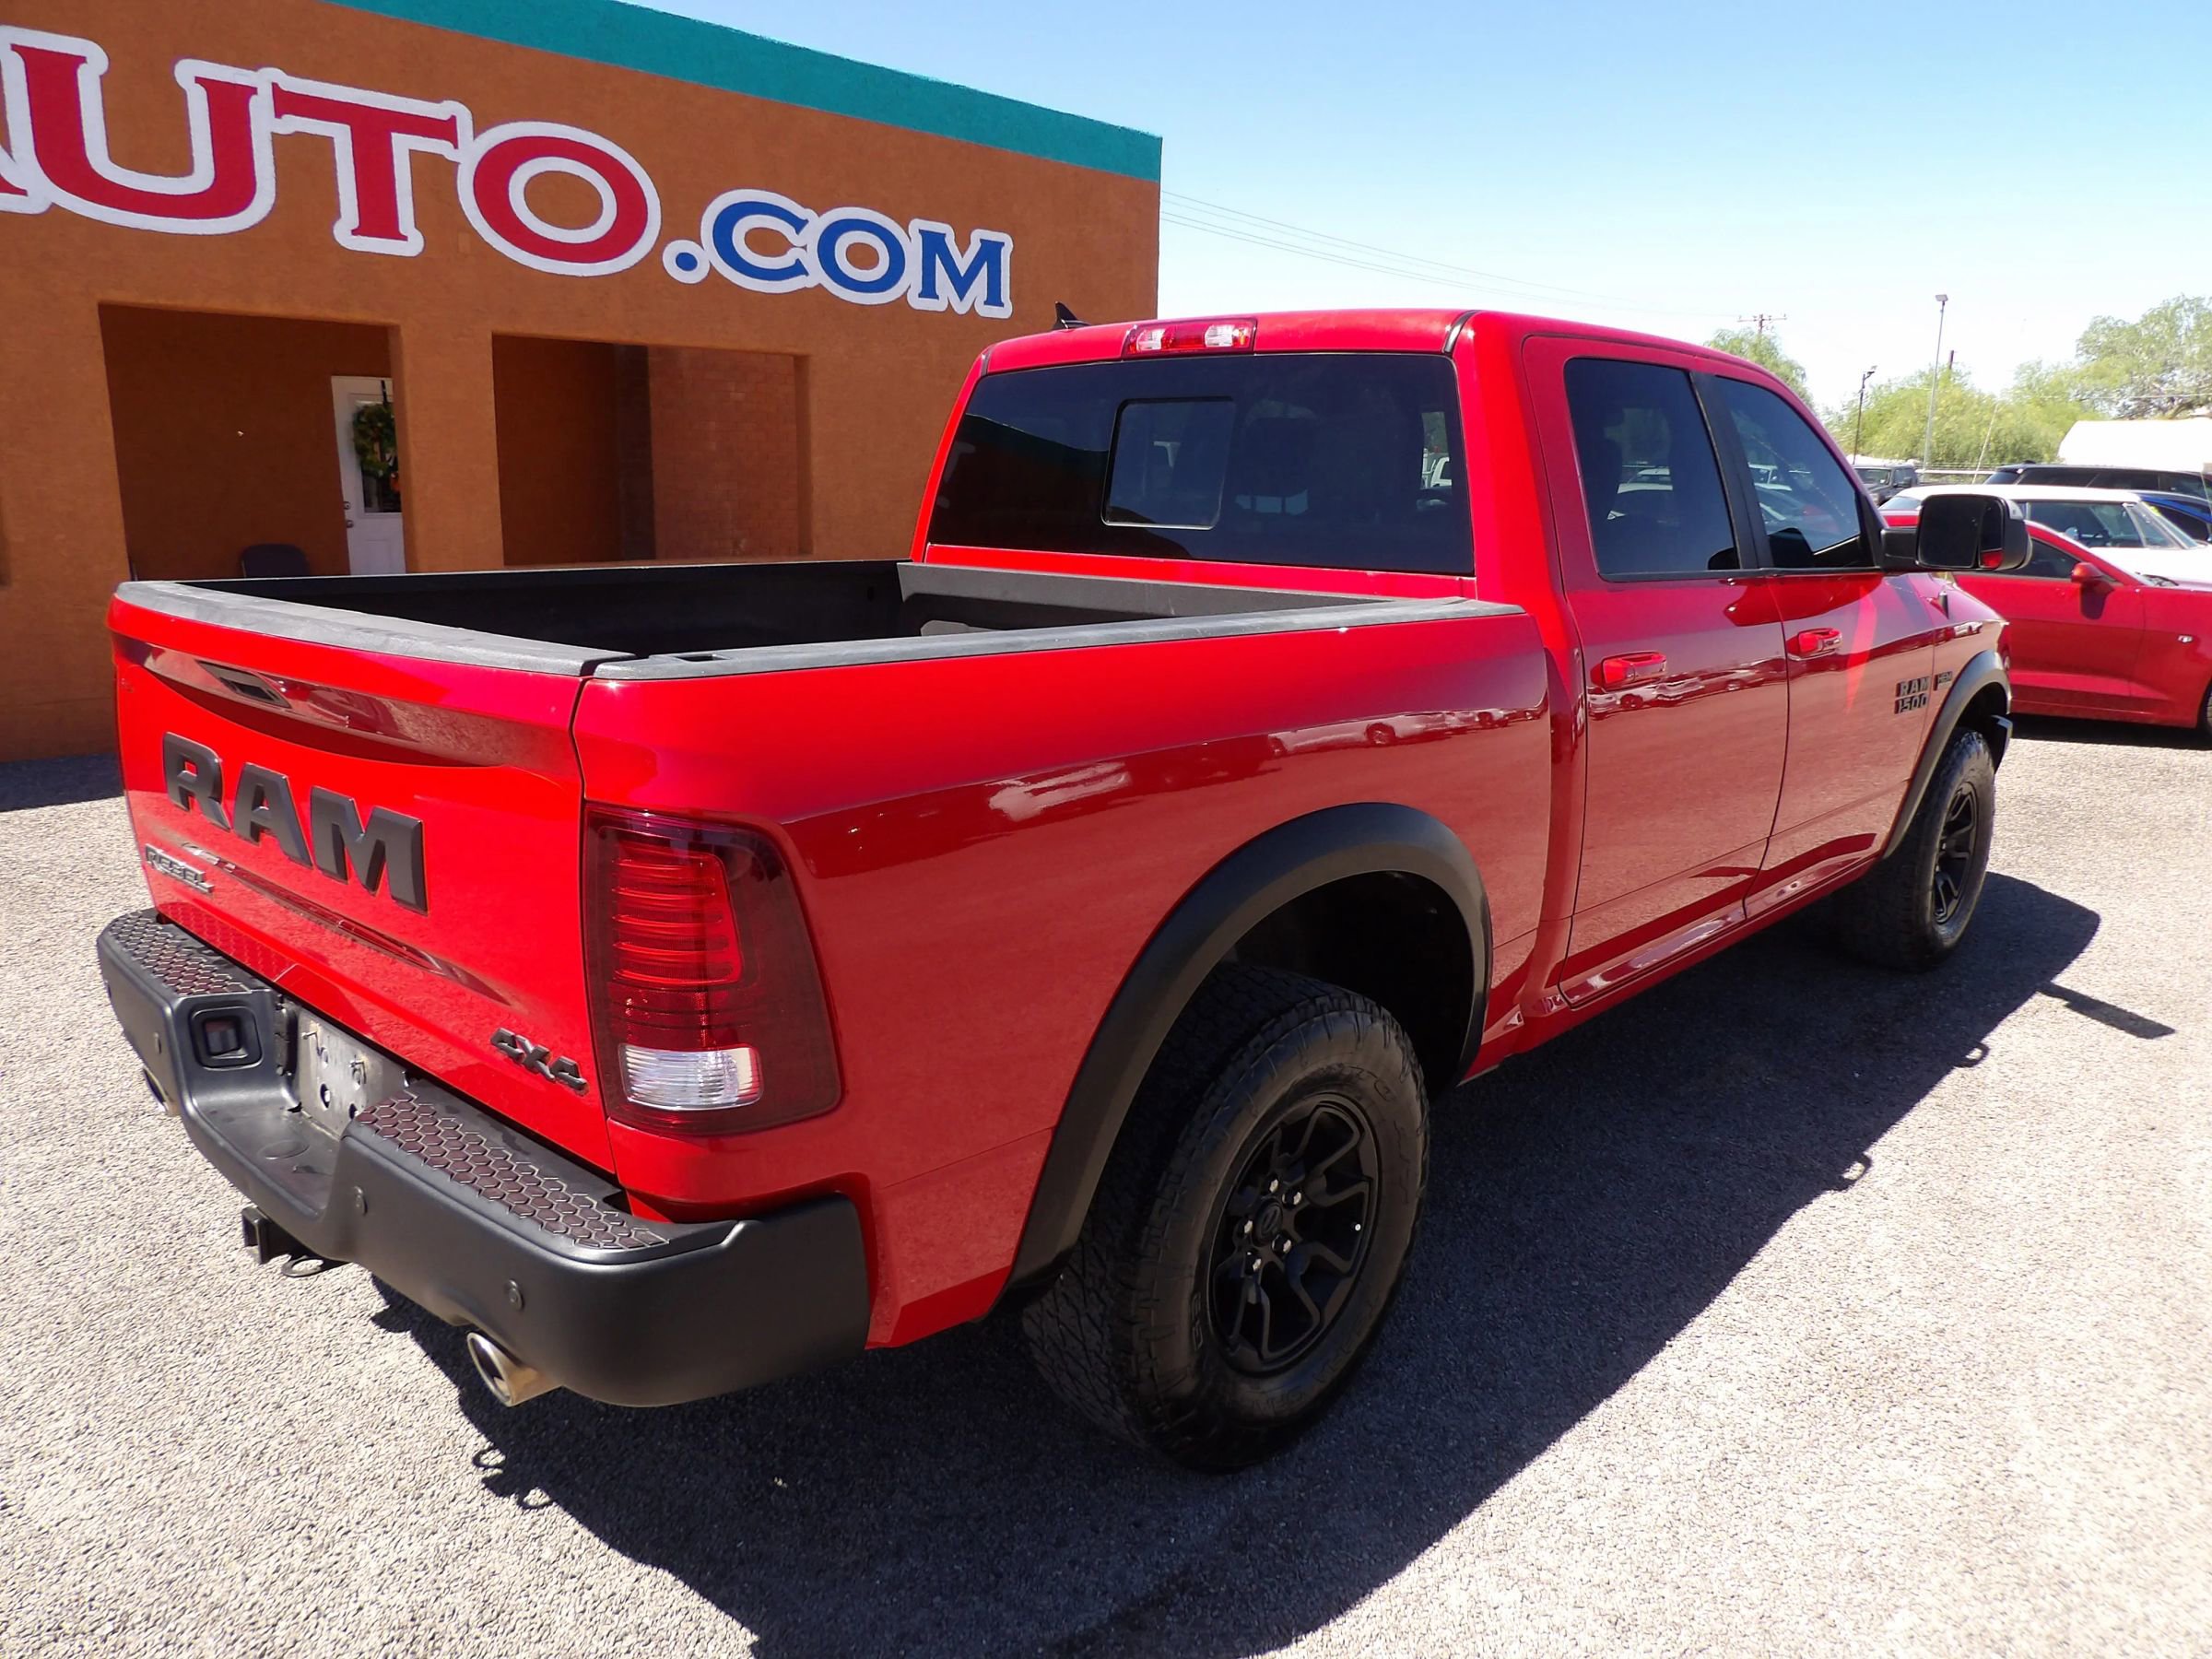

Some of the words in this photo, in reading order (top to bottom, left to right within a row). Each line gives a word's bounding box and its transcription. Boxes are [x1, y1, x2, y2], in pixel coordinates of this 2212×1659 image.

[0, 26, 1013, 318] UTO.COM
[1894, 693, 1928, 714] 1500
[1896, 676, 1931, 697] RAM
[162, 732, 429, 916] RAM
[145, 843, 215, 894] REBEL
